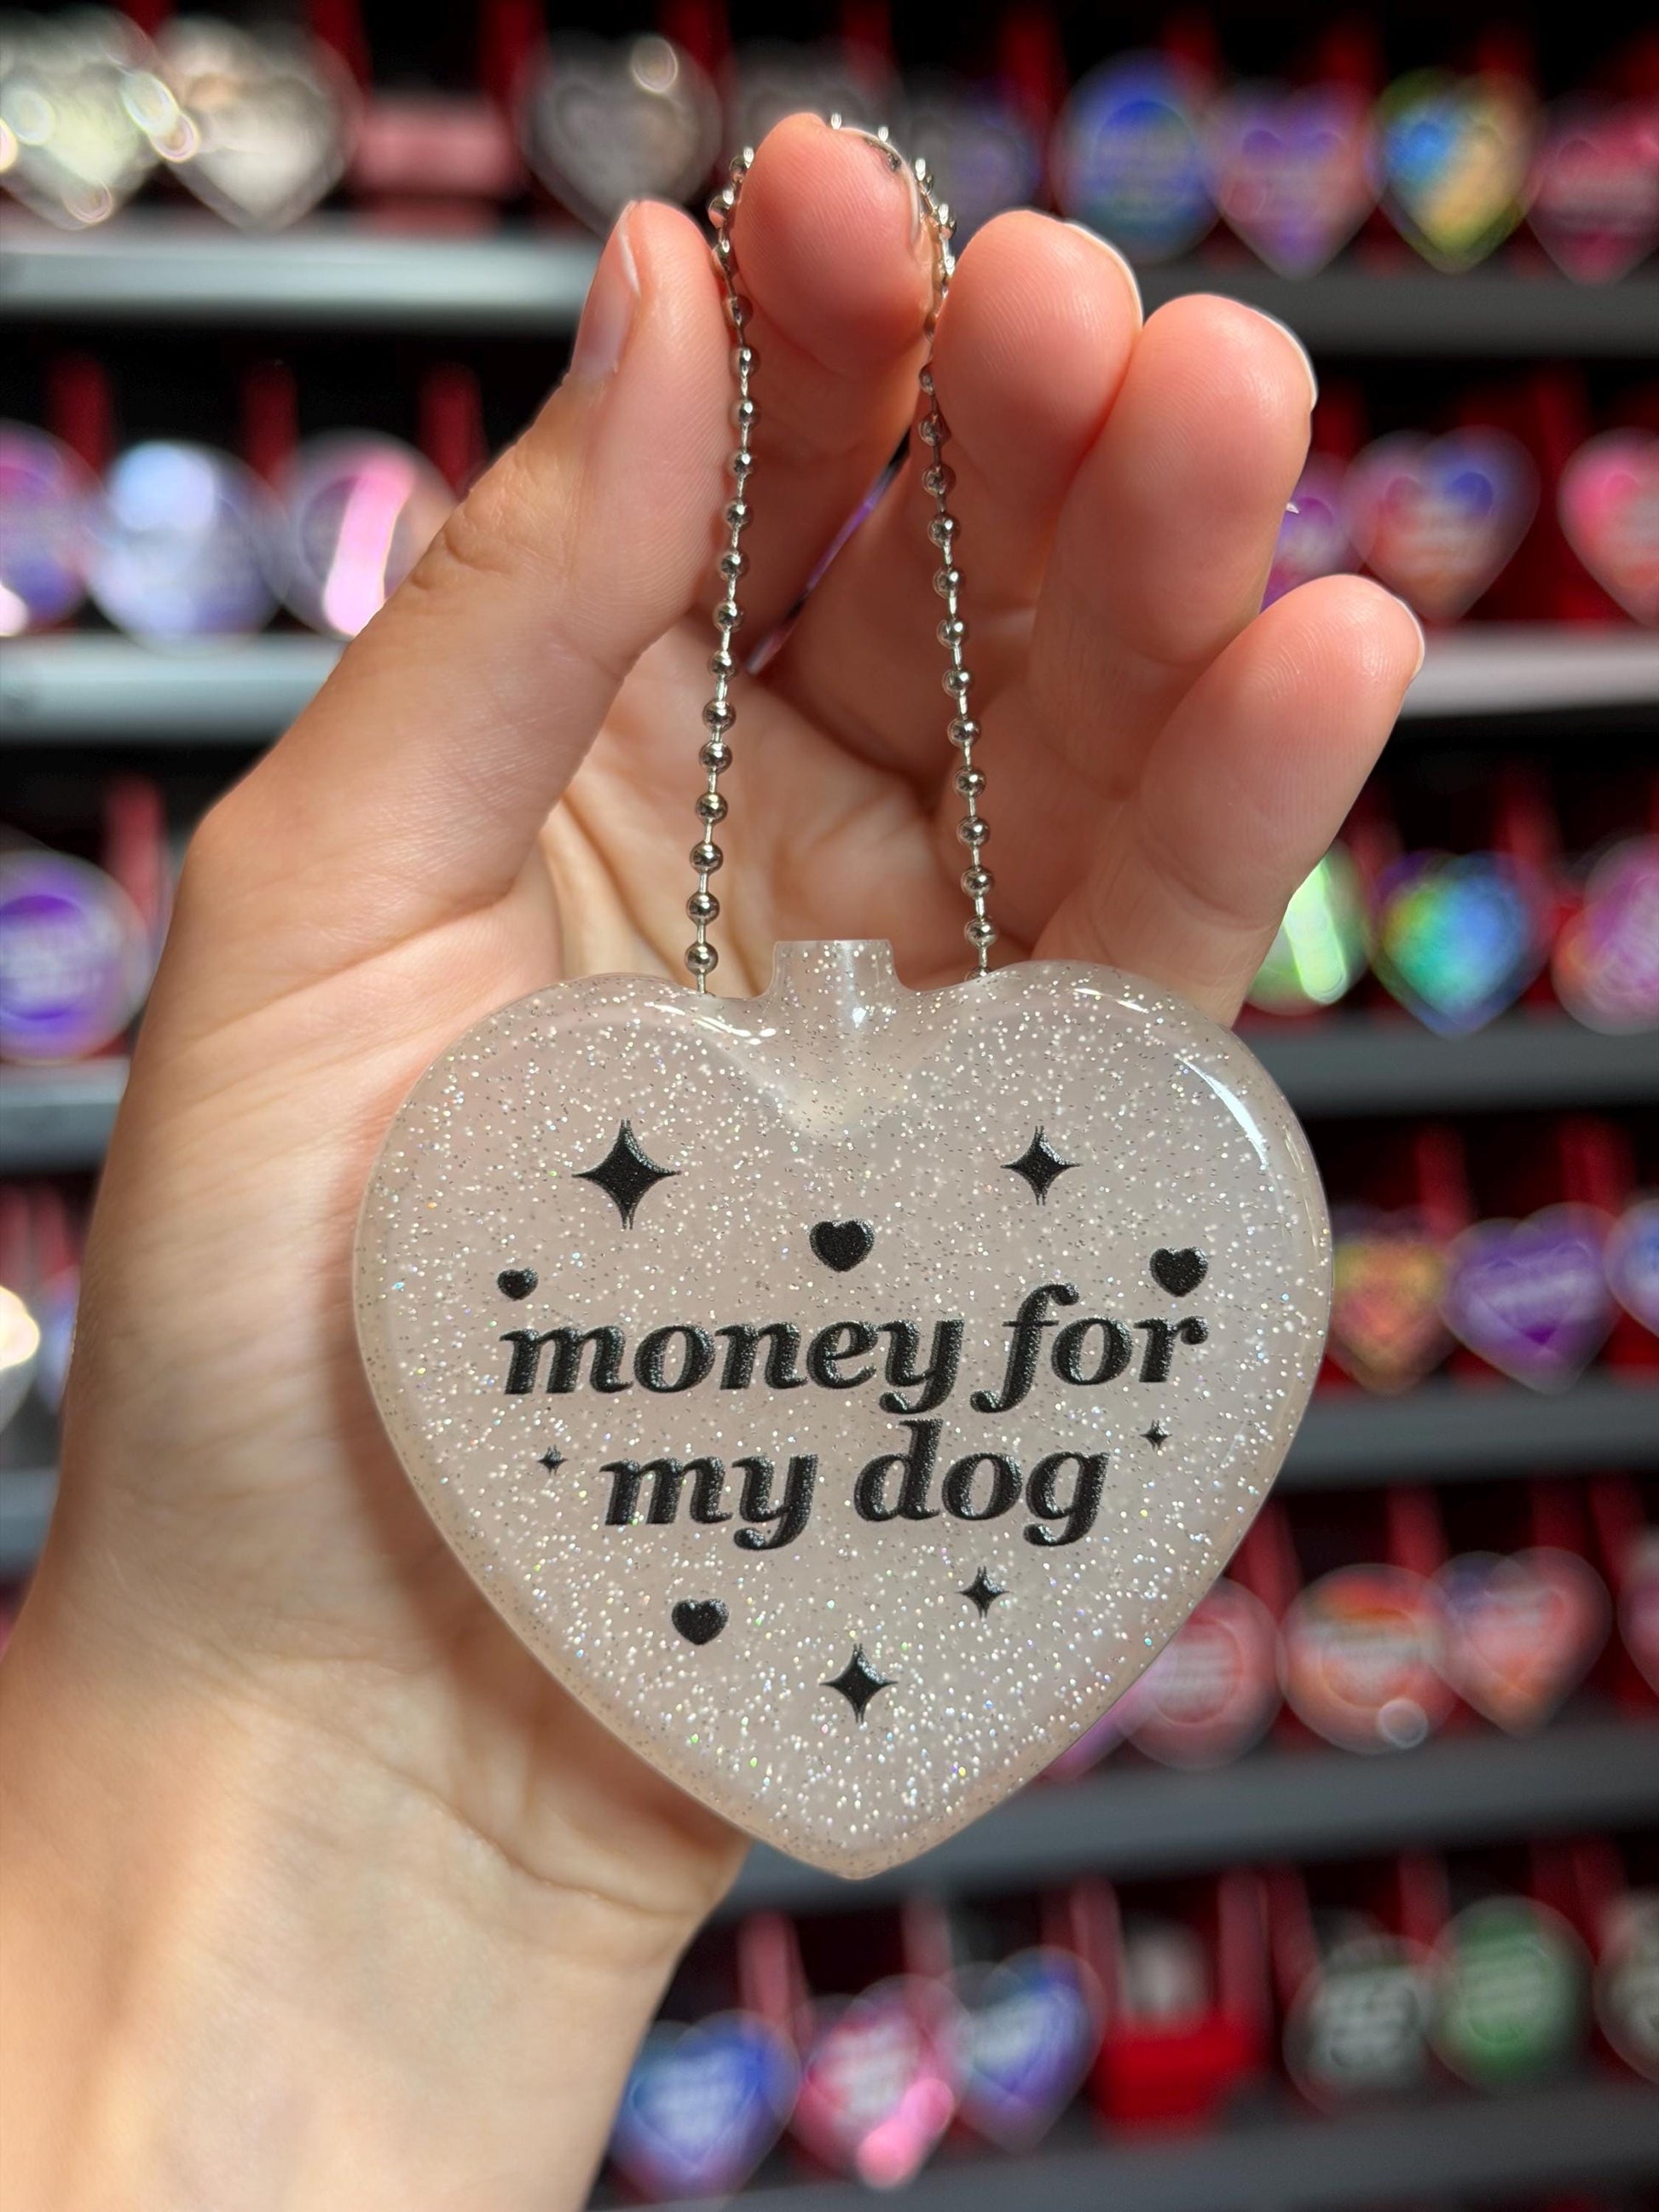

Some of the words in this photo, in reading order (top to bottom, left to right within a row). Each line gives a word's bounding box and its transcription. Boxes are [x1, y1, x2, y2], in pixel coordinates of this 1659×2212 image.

[499, 1318, 965, 1415] money
[969, 1283, 1210, 1415] for
[599, 1454, 819, 1551] my
[853, 1419, 1110, 1547] dog
